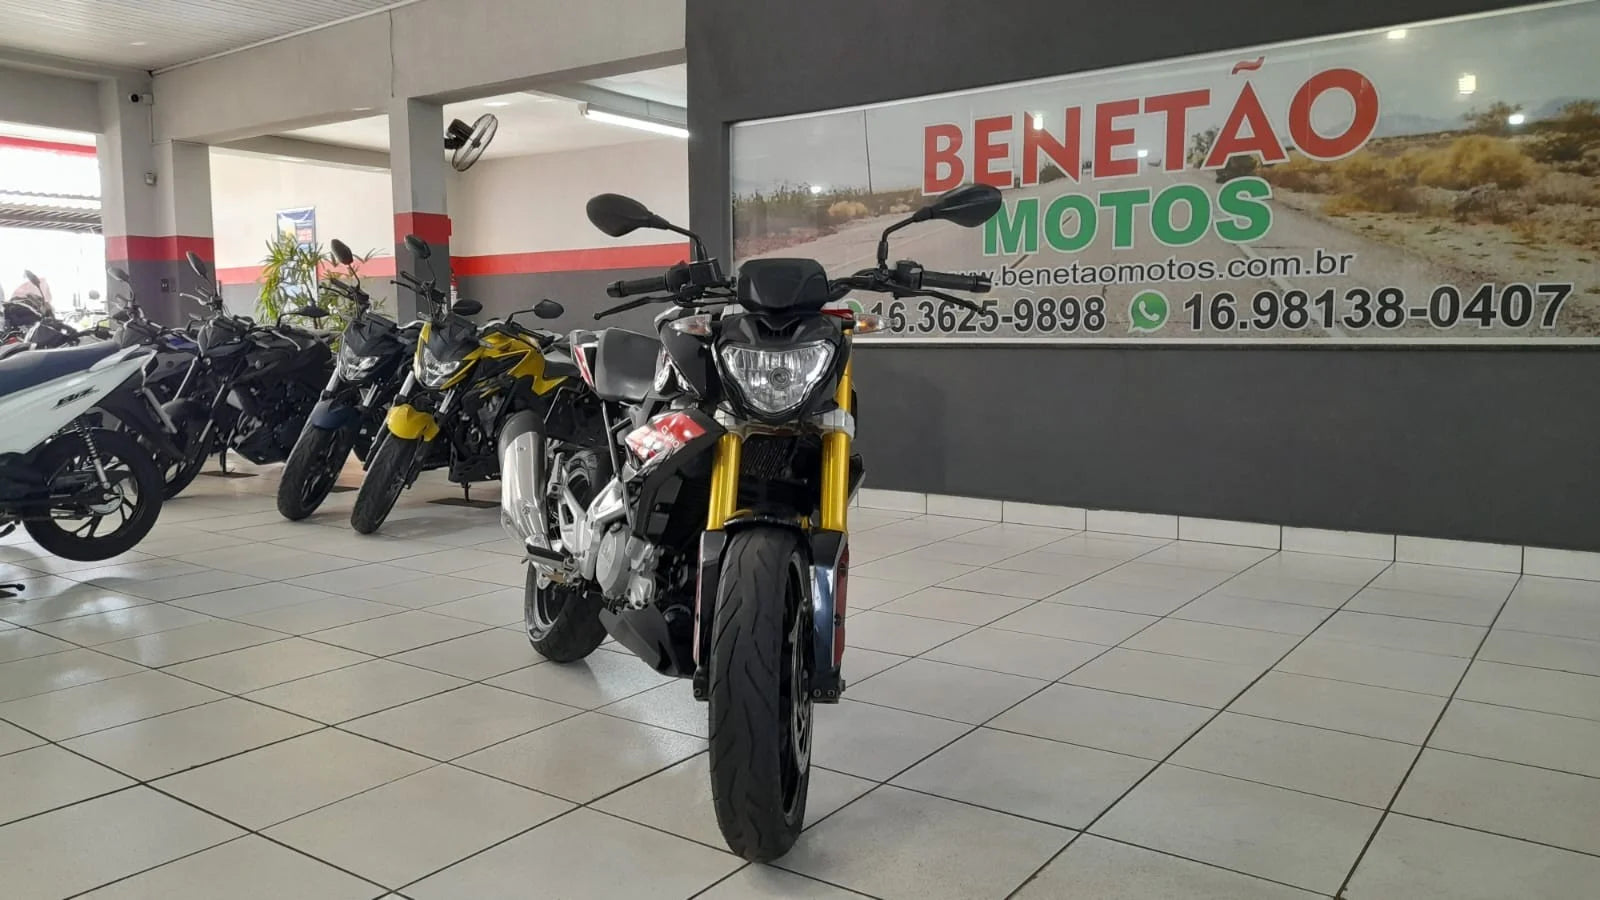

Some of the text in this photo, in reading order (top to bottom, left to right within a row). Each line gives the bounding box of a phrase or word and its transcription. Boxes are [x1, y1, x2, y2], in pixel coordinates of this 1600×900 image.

[923, 55, 1379, 194] BENETÃO
[984, 178, 1272, 255] MOTOS
[952, 250, 1353, 288] .benetaomotos.com.br
[1184, 283, 1572, 330] 16.98138-0407
